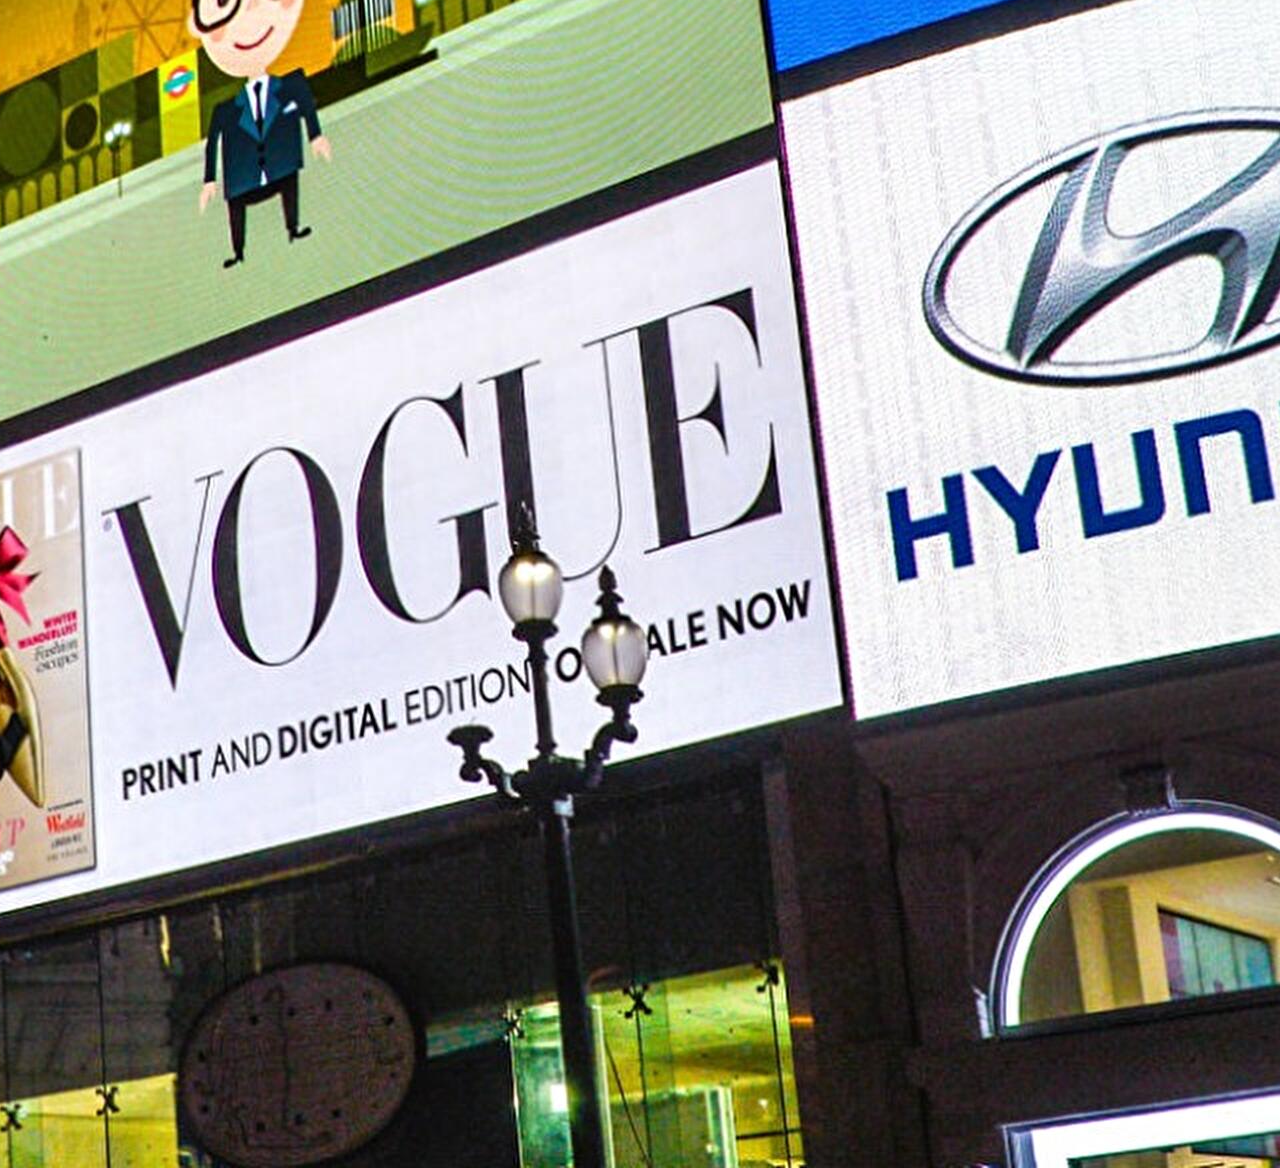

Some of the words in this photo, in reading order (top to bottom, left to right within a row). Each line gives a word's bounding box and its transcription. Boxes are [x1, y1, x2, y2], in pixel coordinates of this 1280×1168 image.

[101, 287, 783, 693] VOGUE
[122, 750, 202, 800] PRINT
[211, 732, 272, 778] AND
[278, 698, 397, 759] DIGITAL
[716, 579, 811, 640] NOW
